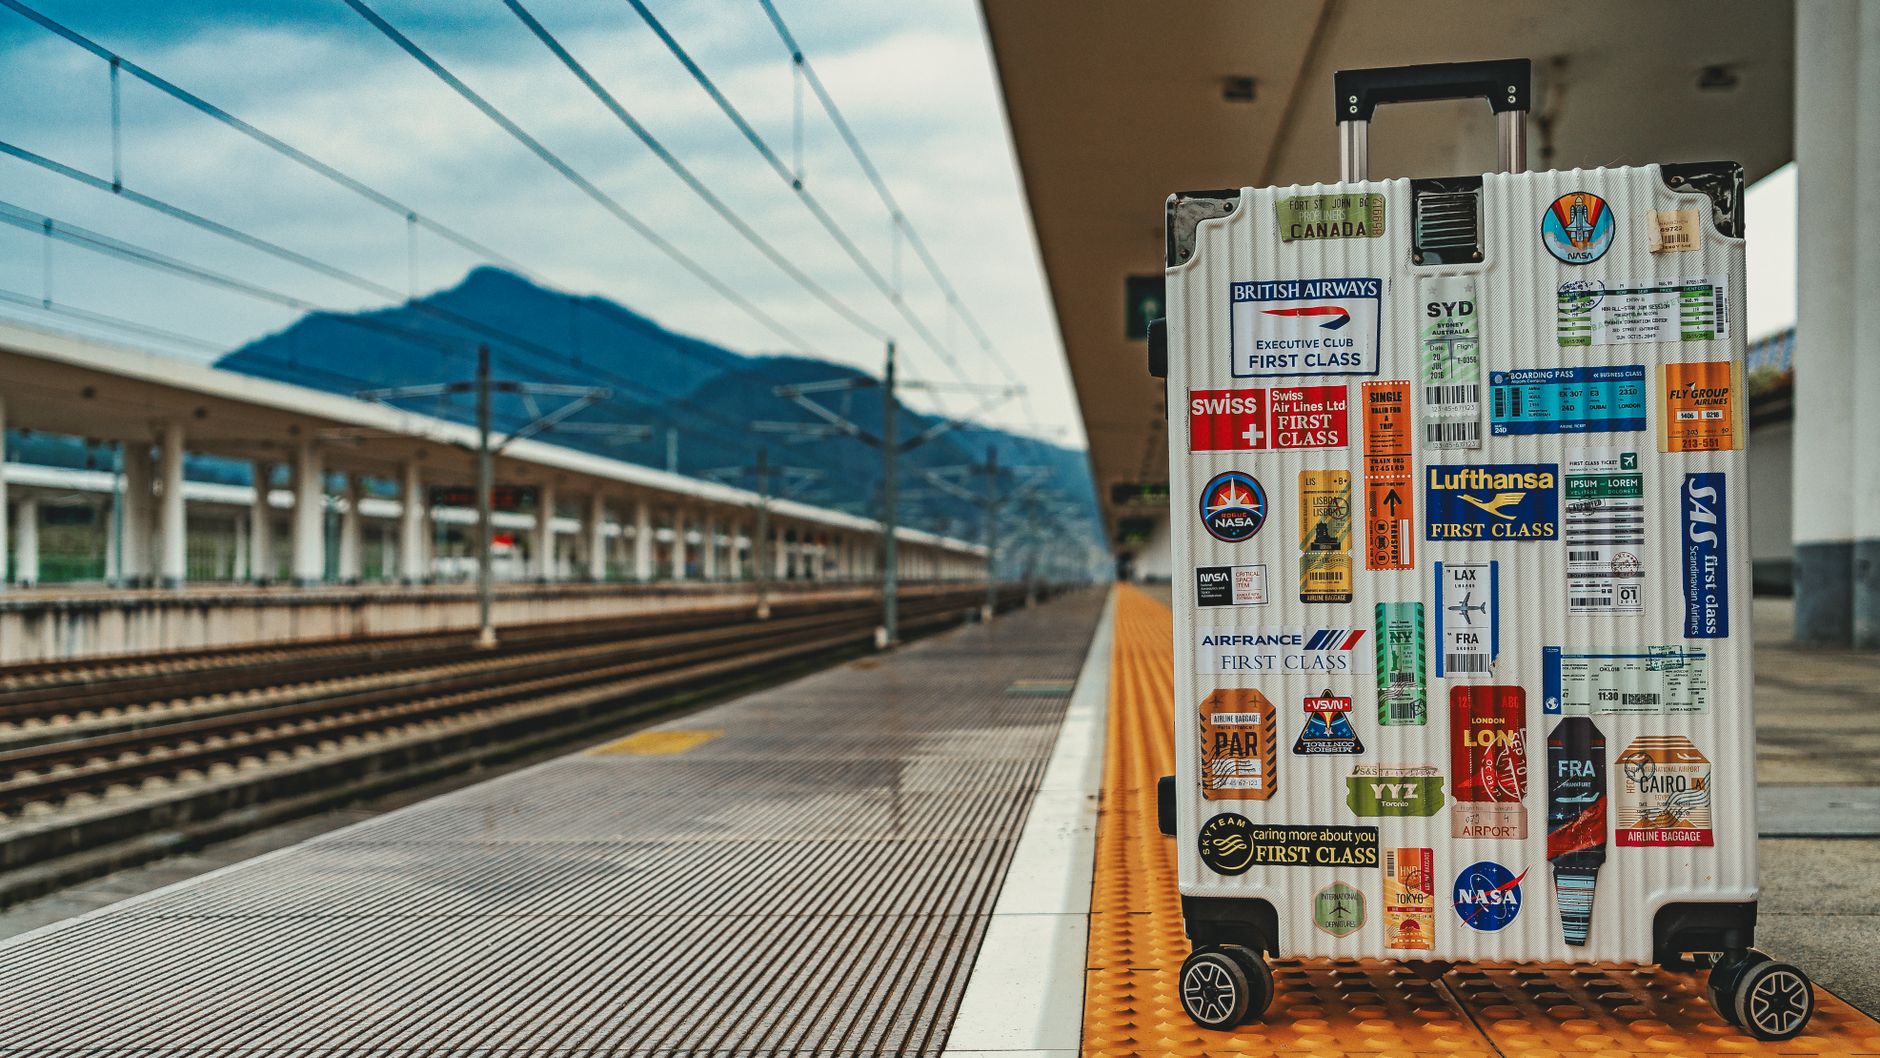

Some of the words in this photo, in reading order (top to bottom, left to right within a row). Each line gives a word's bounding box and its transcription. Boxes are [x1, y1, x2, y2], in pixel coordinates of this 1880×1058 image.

[1289, 200, 1309, 211] FORT
[1314, 199, 1324, 209] ST
[1331, 198, 1351, 209] JOHN
[1359, 197, 1369, 208] BC
[1290, 221, 1366, 238] CANADA
[1568, 252, 1594, 260] NASA
[1234, 283, 1300, 300] BRITISH
[1304, 281, 1378, 298] AIRWAYS
[1427, 300, 1474, 318] SYD
[1256, 339, 1320, 350] EXECUTIVE
[1323, 338, 1354, 348] CLUB
[1250, 354, 1298, 368] FIRST
[1304, 352, 1361, 367] CLASS
[1510, 371, 1553, 380] BOARDING
[1555, 370, 1574, 378] PASS
[1272, 390, 1304, 401] Swiss
[1370, 392, 1402, 402] SINGLE
[1570, 390, 1583, 398] 307
[1670, 390, 1689, 400] FLY
[1691, 388, 1728, 398] GROUP
[1192, 392, 1257, 416] swiss
[1272, 402, 1290, 413] Air
[1294, 401, 1323, 412] Lines
[1278, 414, 1332, 430] FIRST
[1278, 430, 1339, 446] CLASS
[1682, 439, 1719, 448] 213-551
[1431, 469, 1553, 490] Lufthansa
[1570, 480, 1597, 488] IPSUM
[1608, 479, 1638, 487] LOREM
[1688, 478, 1718, 549] SAS
[1215, 518, 1254, 528] NASA
[1431, 524, 1485, 537] FIRST
[1492, 523, 1554, 537] CLASS
[1200, 573, 1228, 582] NASA
[1454, 570, 1476, 580] LAX
[1689, 546, 1700, 601] Scandinavian
[1704, 555, 1718, 590] first
[1621, 589, 1636, 600] 01
[1690, 603, 1700, 635] Airlines
[1705, 595, 1718, 634] class
[1201, 635, 1302, 646] AIRFRANCE
[1390, 631, 1412, 643] NY
[1456, 633, 1479, 644] FRA
[1221, 656, 1276, 669] FIRST
[1284, 655, 1346, 670] CLASS
[1598, 692, 1618, 701] 11:30
[1312, 700, 1343, 709] NASA
[1214, 715, 1234, 723] AIRLINE
[1235, 715, 1258, 723] BAGGAGE
[1215, 732, 1258, 756] PAR
[1464, 730, 1514, 747] LON
[1558, 760, 1596, 778] FRA
[1640, 775, 1686, 793] CAIRO
[1696, 779, 1701, 789] A
[1370, 783, 1418, 799] YYZ
[1203, 817, 1246, 855] SKYTEAM
[1253, 828, 1286, 844] caring
[1289, 831, 1317, 840] more
[1320, 829, 1352, 842] about
[1354, 833, 1376, 844] you
[1462, 826, 1517, 836] AIRPORT
[1628, 832, 1659, 842] AIRLINE
[1661, 831, 1701, 842] BAGGAGE
[1256, 845, 1311, 862] FIRST
[1316, 846, 1376, 864] CLASS
[1400, 866, 1418, 876] HND
[1396, 894, 1424, 904] TOKYO
[1459, 889, 1518, 904] NASA
